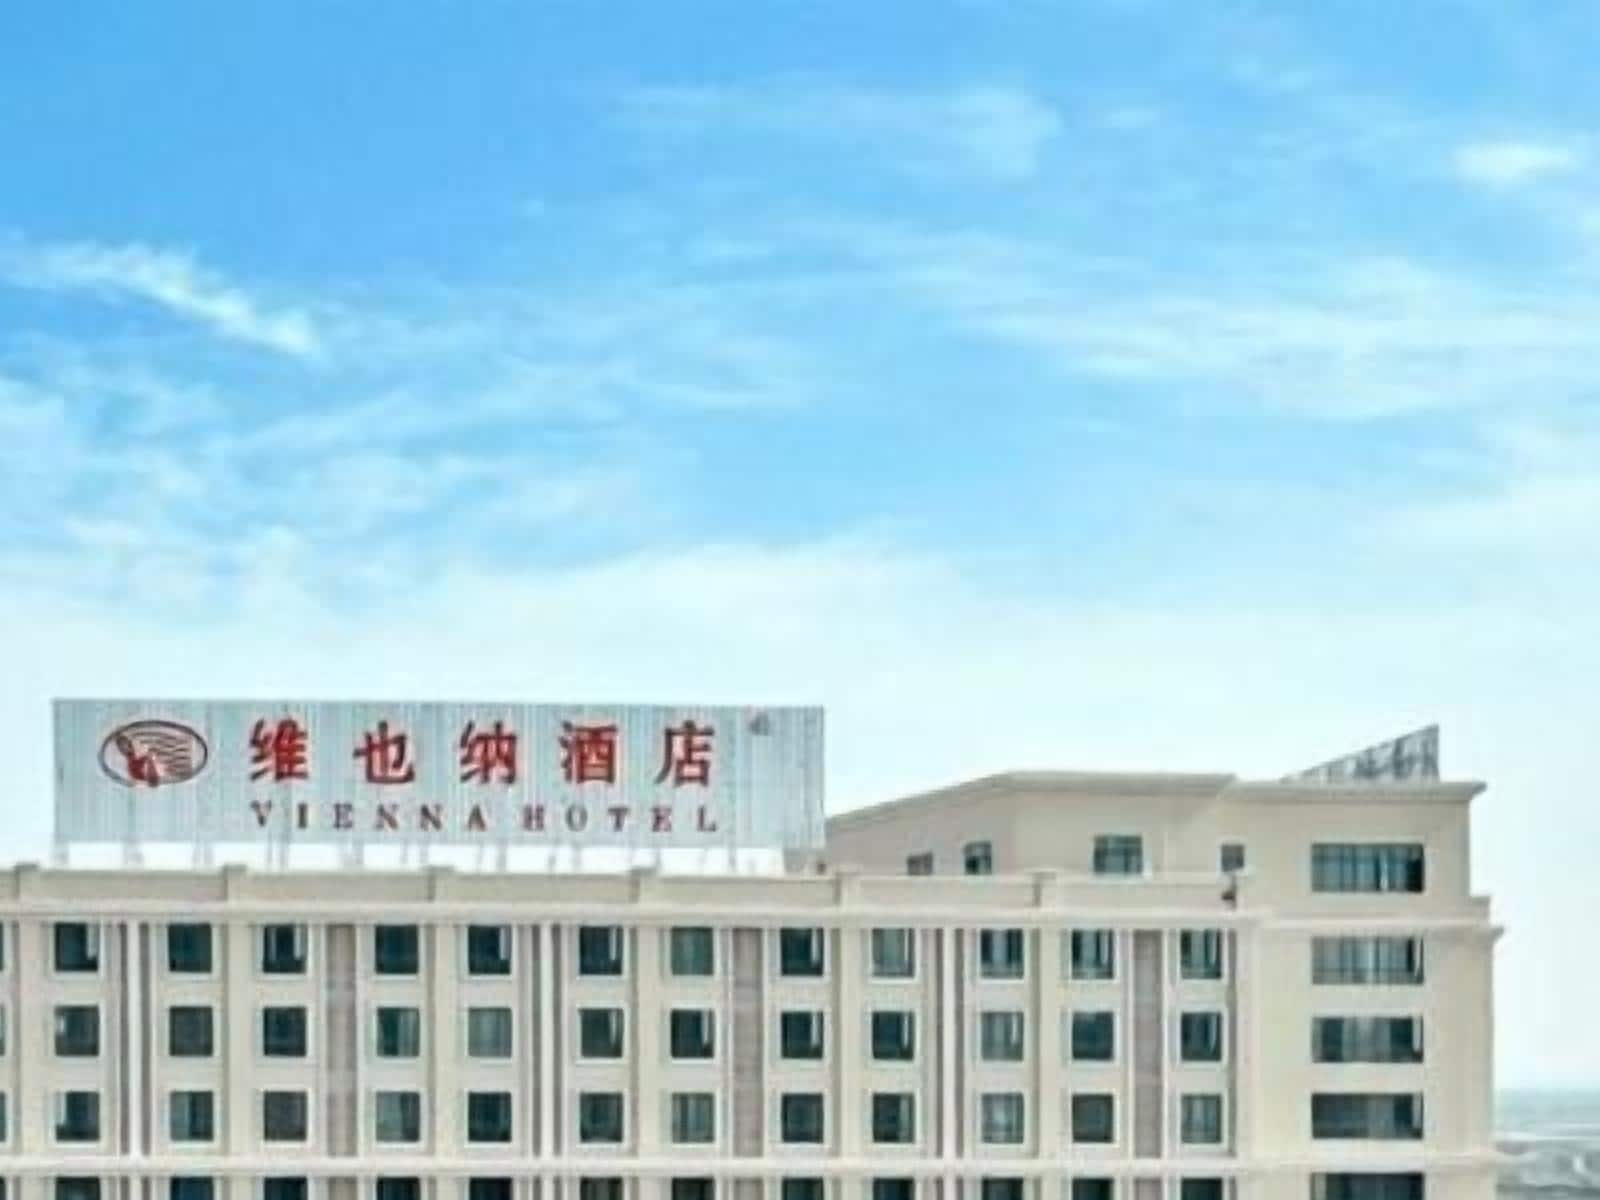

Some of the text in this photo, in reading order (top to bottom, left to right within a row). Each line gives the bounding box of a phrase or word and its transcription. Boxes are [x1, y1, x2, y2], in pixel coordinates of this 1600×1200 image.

[249, 718, 715, 787] 维也纳酒店
[250, 800, 717, 833] VIENNA HOTEL
